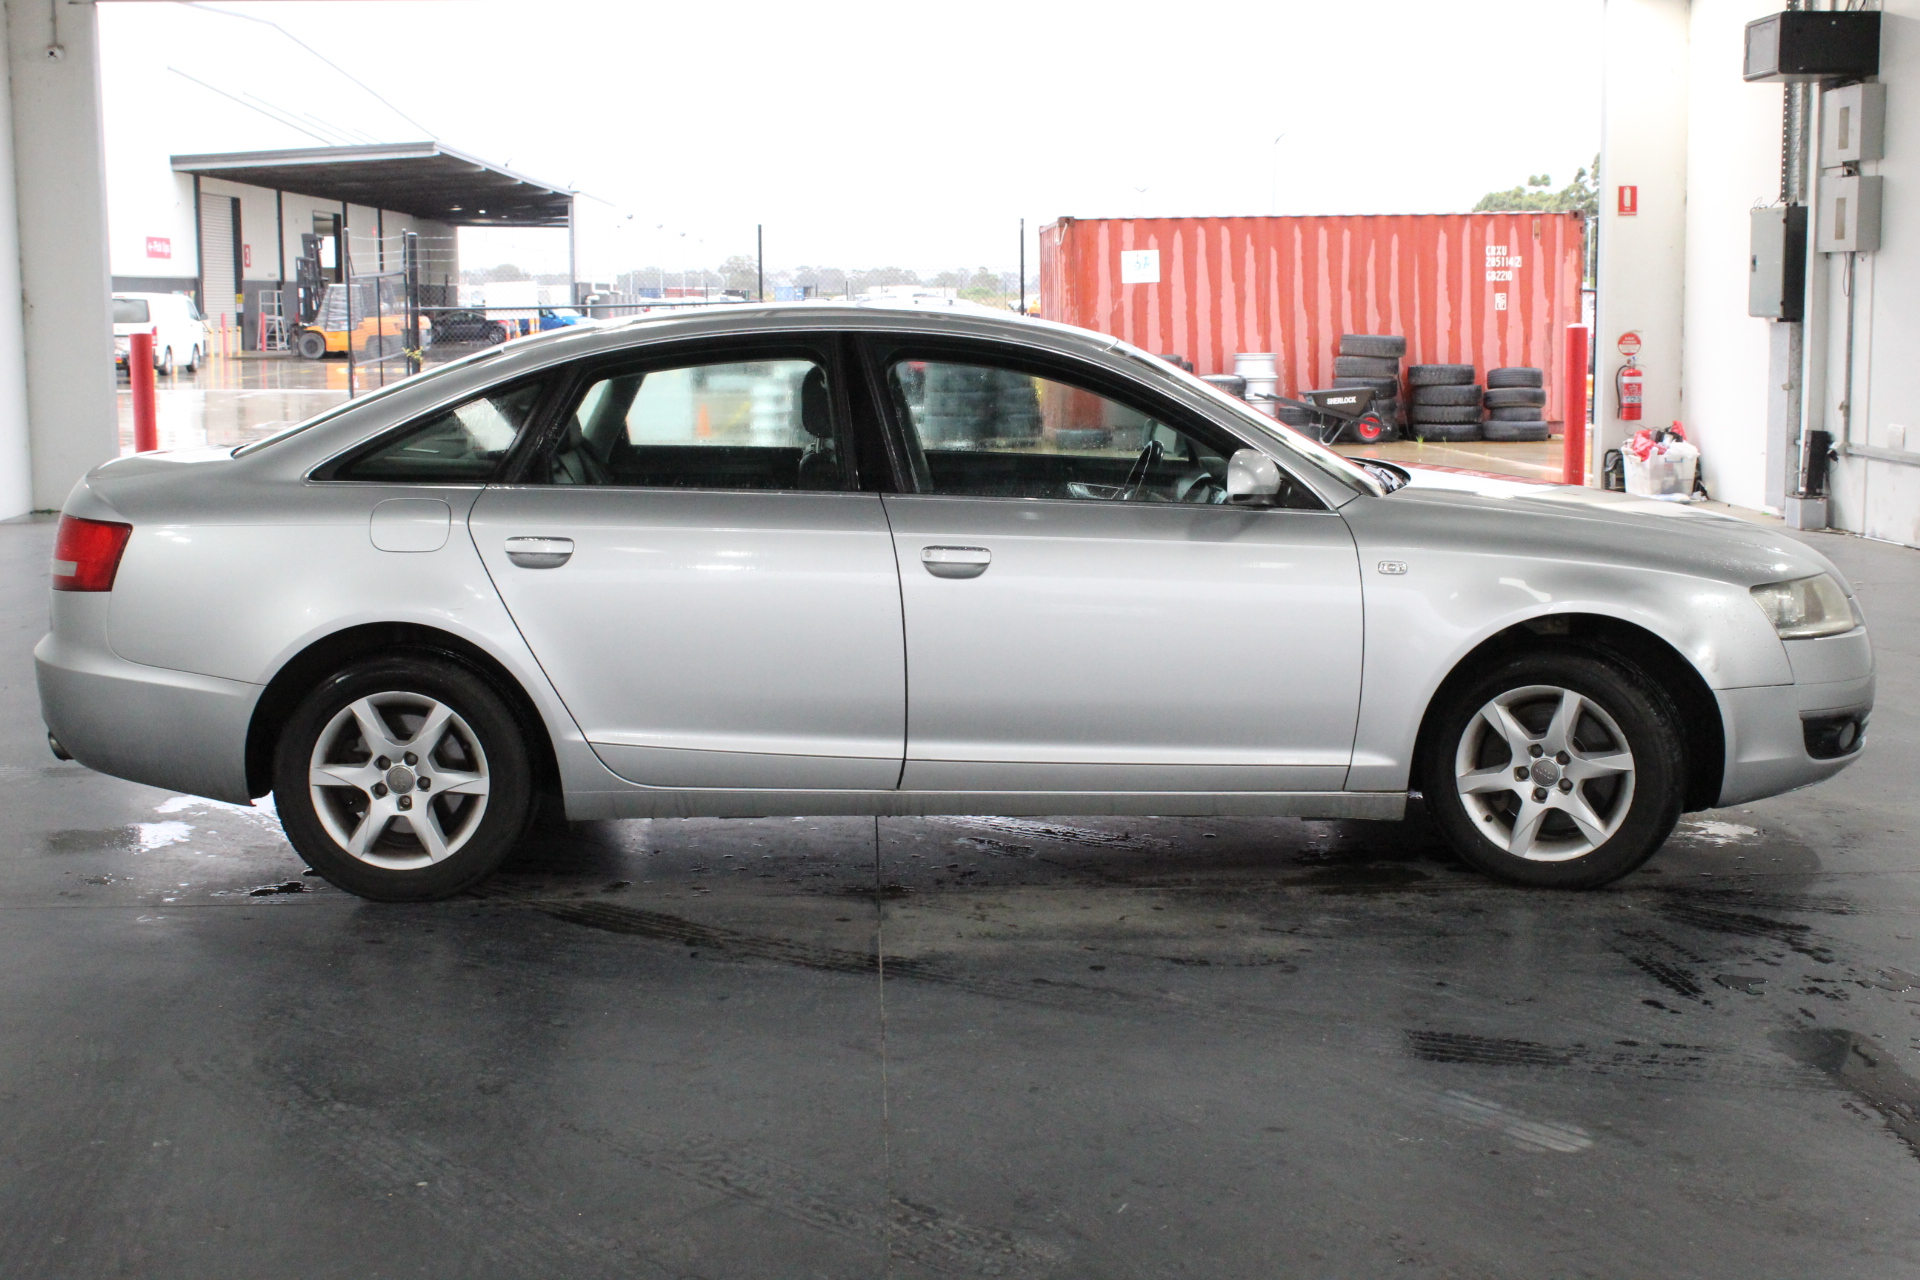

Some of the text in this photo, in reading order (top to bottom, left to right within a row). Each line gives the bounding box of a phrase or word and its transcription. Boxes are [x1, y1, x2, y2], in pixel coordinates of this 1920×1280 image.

[1485, 245, 1508, 256] CRXU
[1485, 270, 1513, 281] GB2210
[1326, 396, 1357, 405] SHERLOCK
